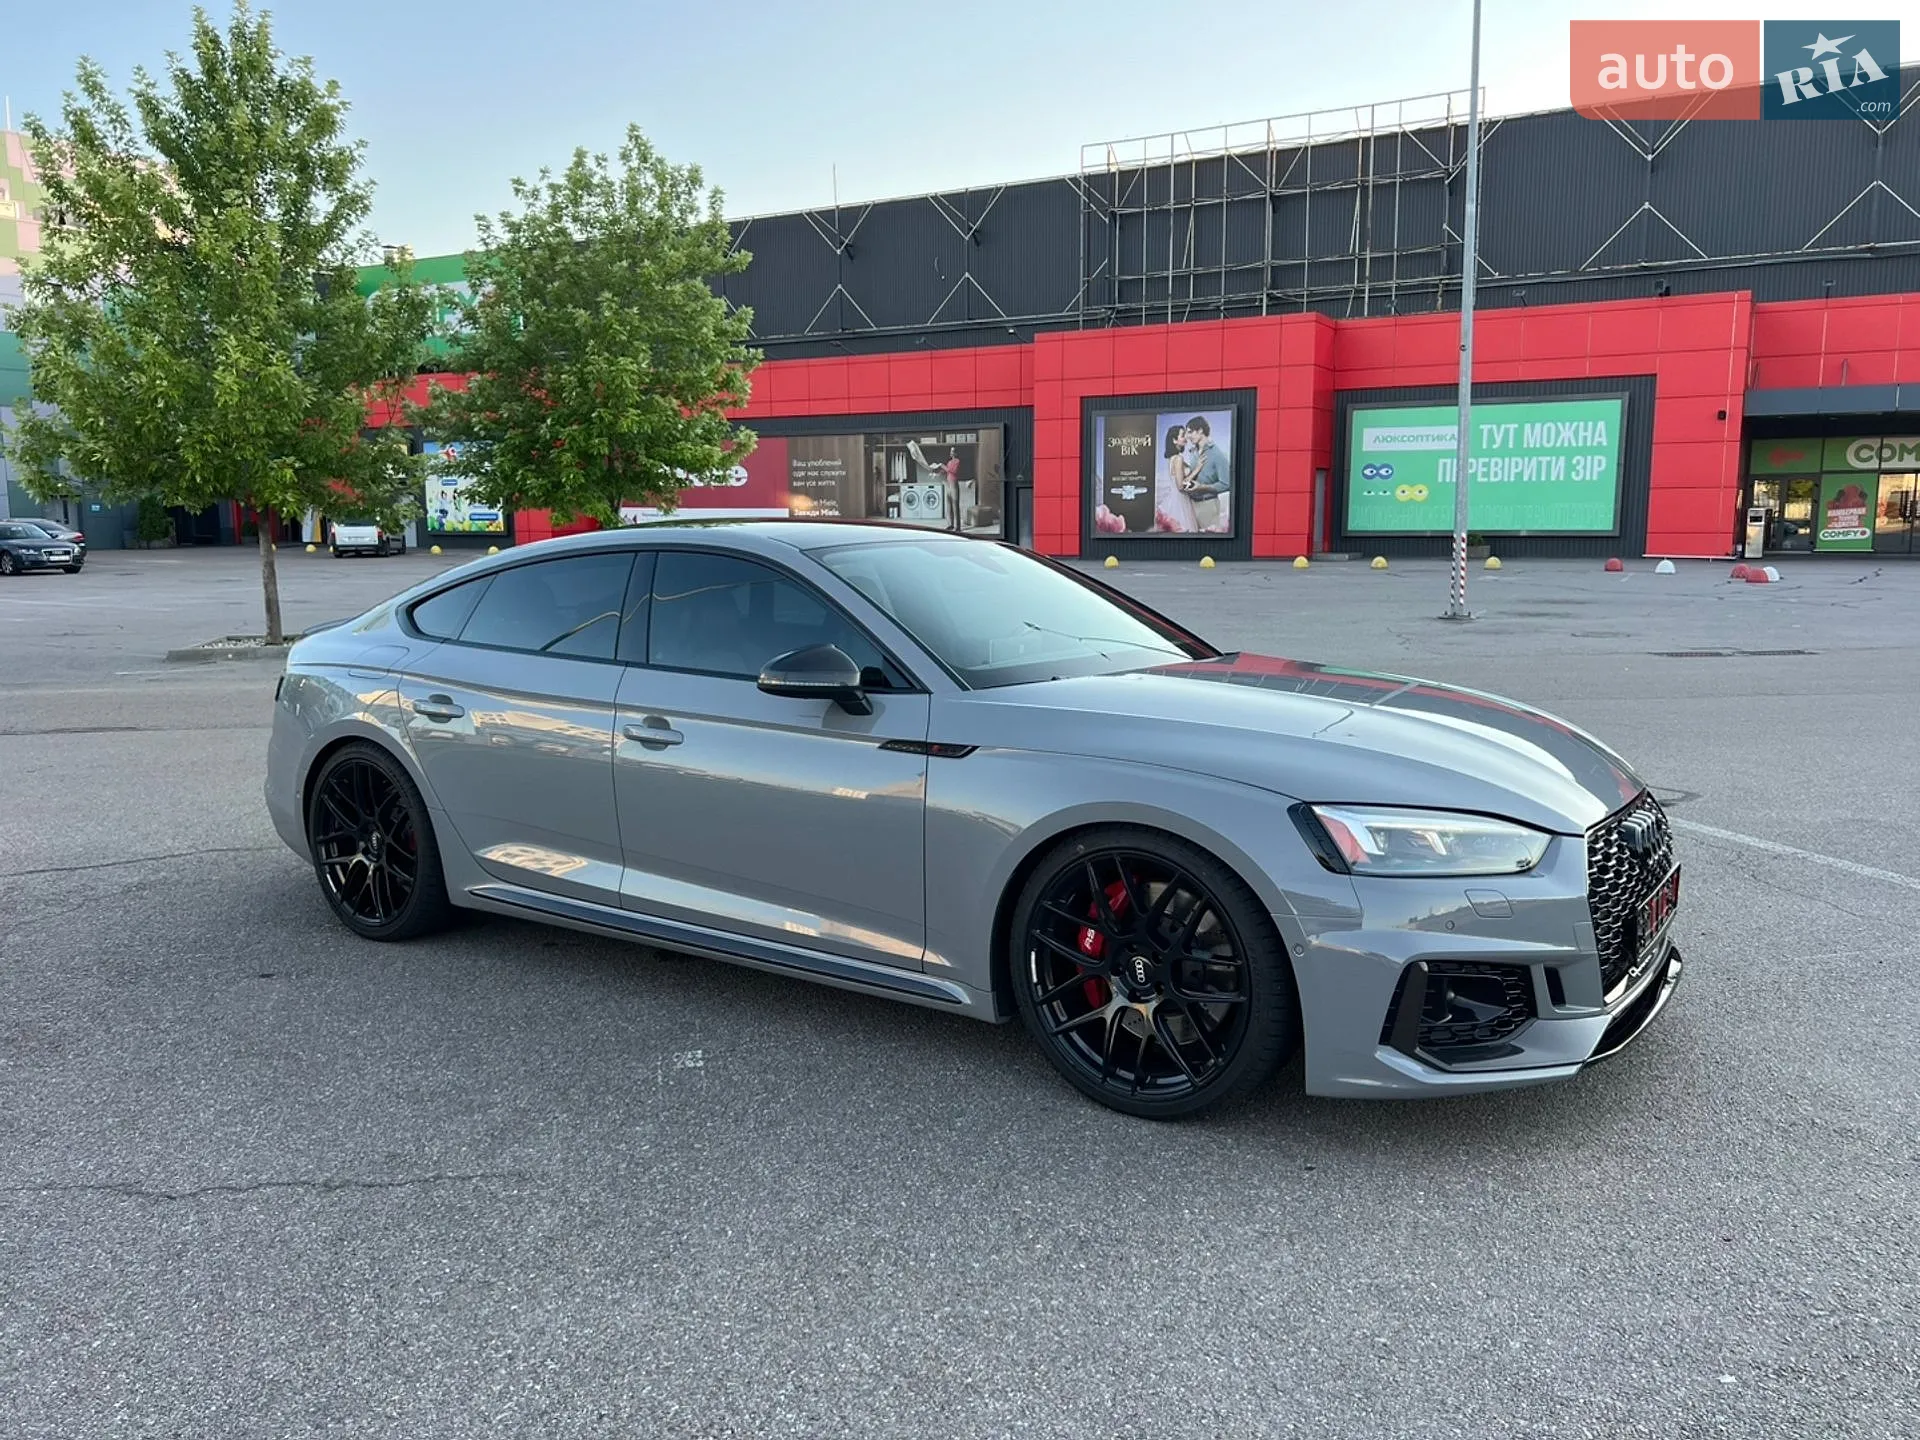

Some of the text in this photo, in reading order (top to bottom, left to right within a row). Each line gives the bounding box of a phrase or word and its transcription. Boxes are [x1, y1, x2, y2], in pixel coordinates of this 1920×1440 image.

[1373, 432, 1457, 444] ЛЮКСОПТИКА
[1479, 420, 1608, 449] ТУТ МОЖНА
[1571, 455, 1606, 481] ЗІР
[1822, 529, 1860, 538] COMFY
[1084, 928, 1095, 950] RS
